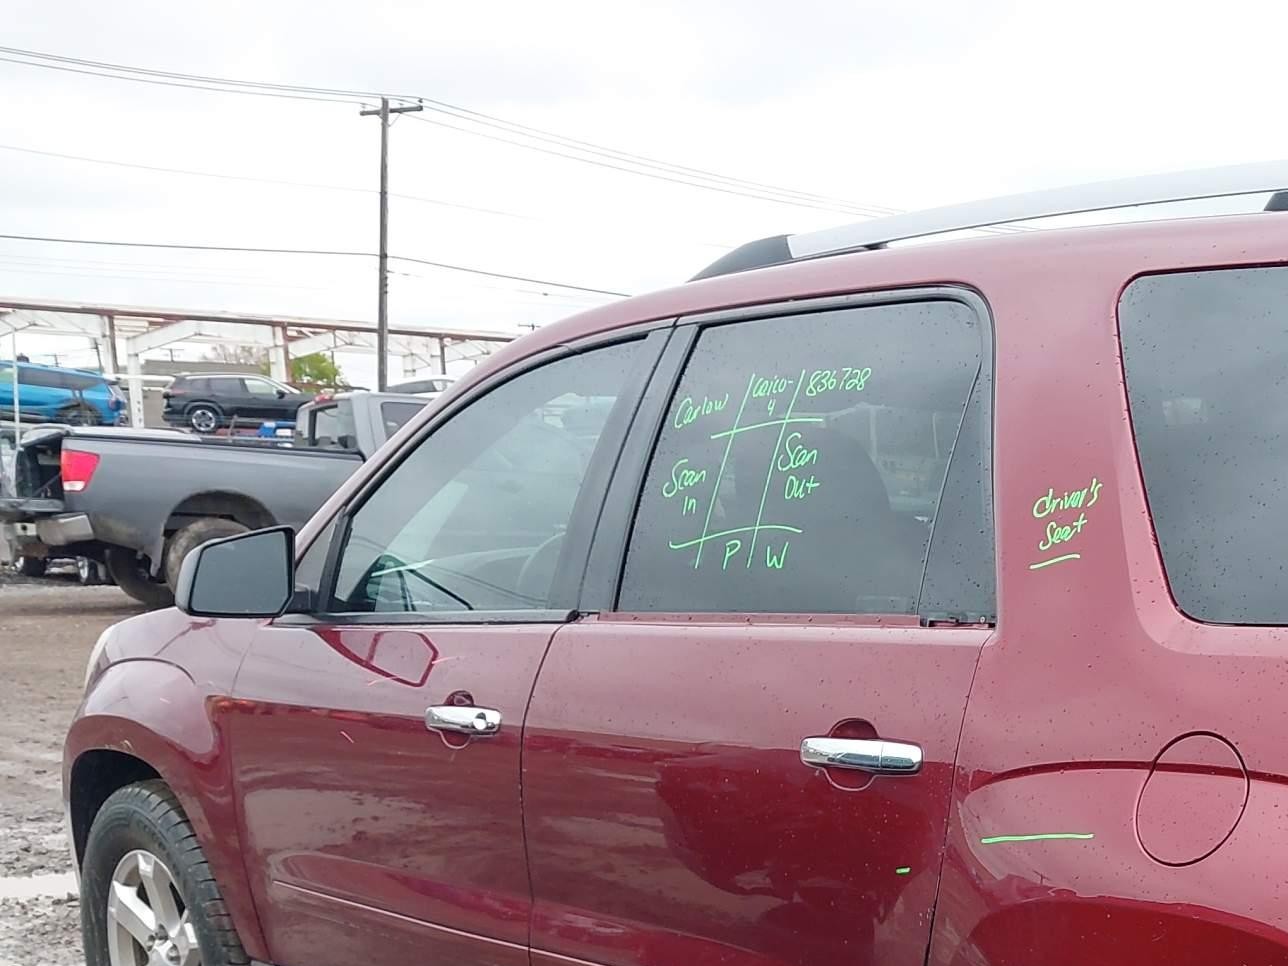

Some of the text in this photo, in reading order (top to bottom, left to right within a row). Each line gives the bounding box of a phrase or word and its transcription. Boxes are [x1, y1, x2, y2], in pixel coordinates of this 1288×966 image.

[805, 367, 871, 397] 836728
[777, 432, 818, 471] Scan
[662, 458, 706, 498] Scan
[722, 539, 742, 570] P
[765, 541, 789, 569] W
